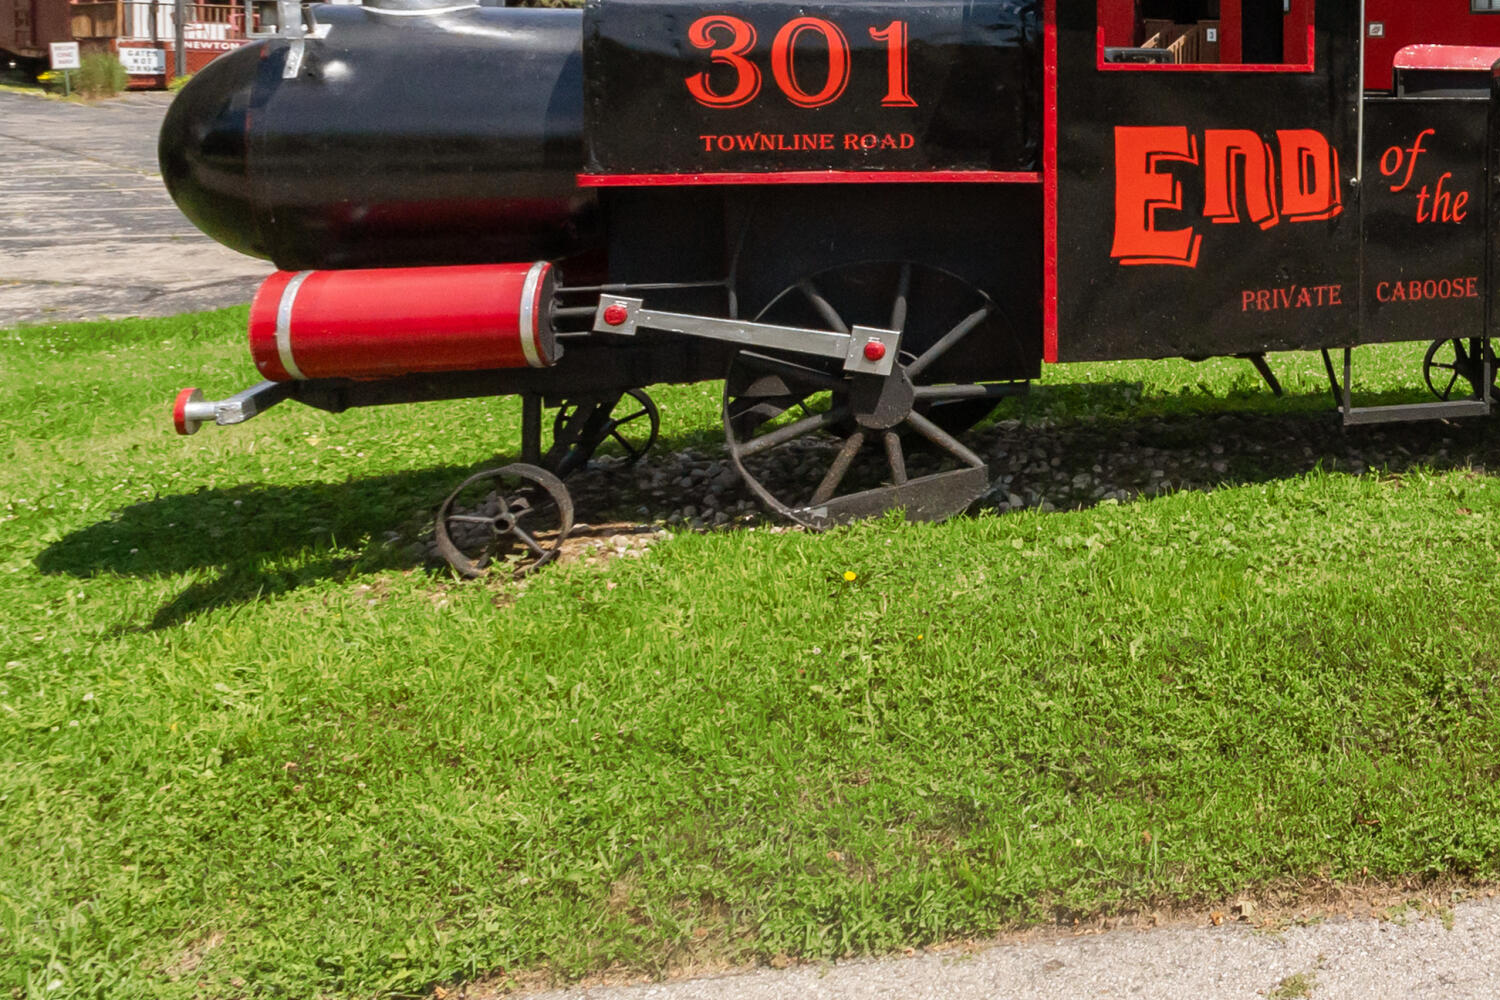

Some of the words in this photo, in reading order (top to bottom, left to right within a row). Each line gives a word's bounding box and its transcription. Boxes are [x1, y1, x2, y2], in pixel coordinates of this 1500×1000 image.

[684, 14, 919, 109] 301
[699, 131, 835, 152] TOWNLINE
[843, 132, 915, 151] ROAD
[1380, 128, 1436, 193] of
[1415, 171, 1469, 224] the
[1240, 283, 1343, 313] PRIVATE
[1375, 276, 1479, 303] CABOOSE
